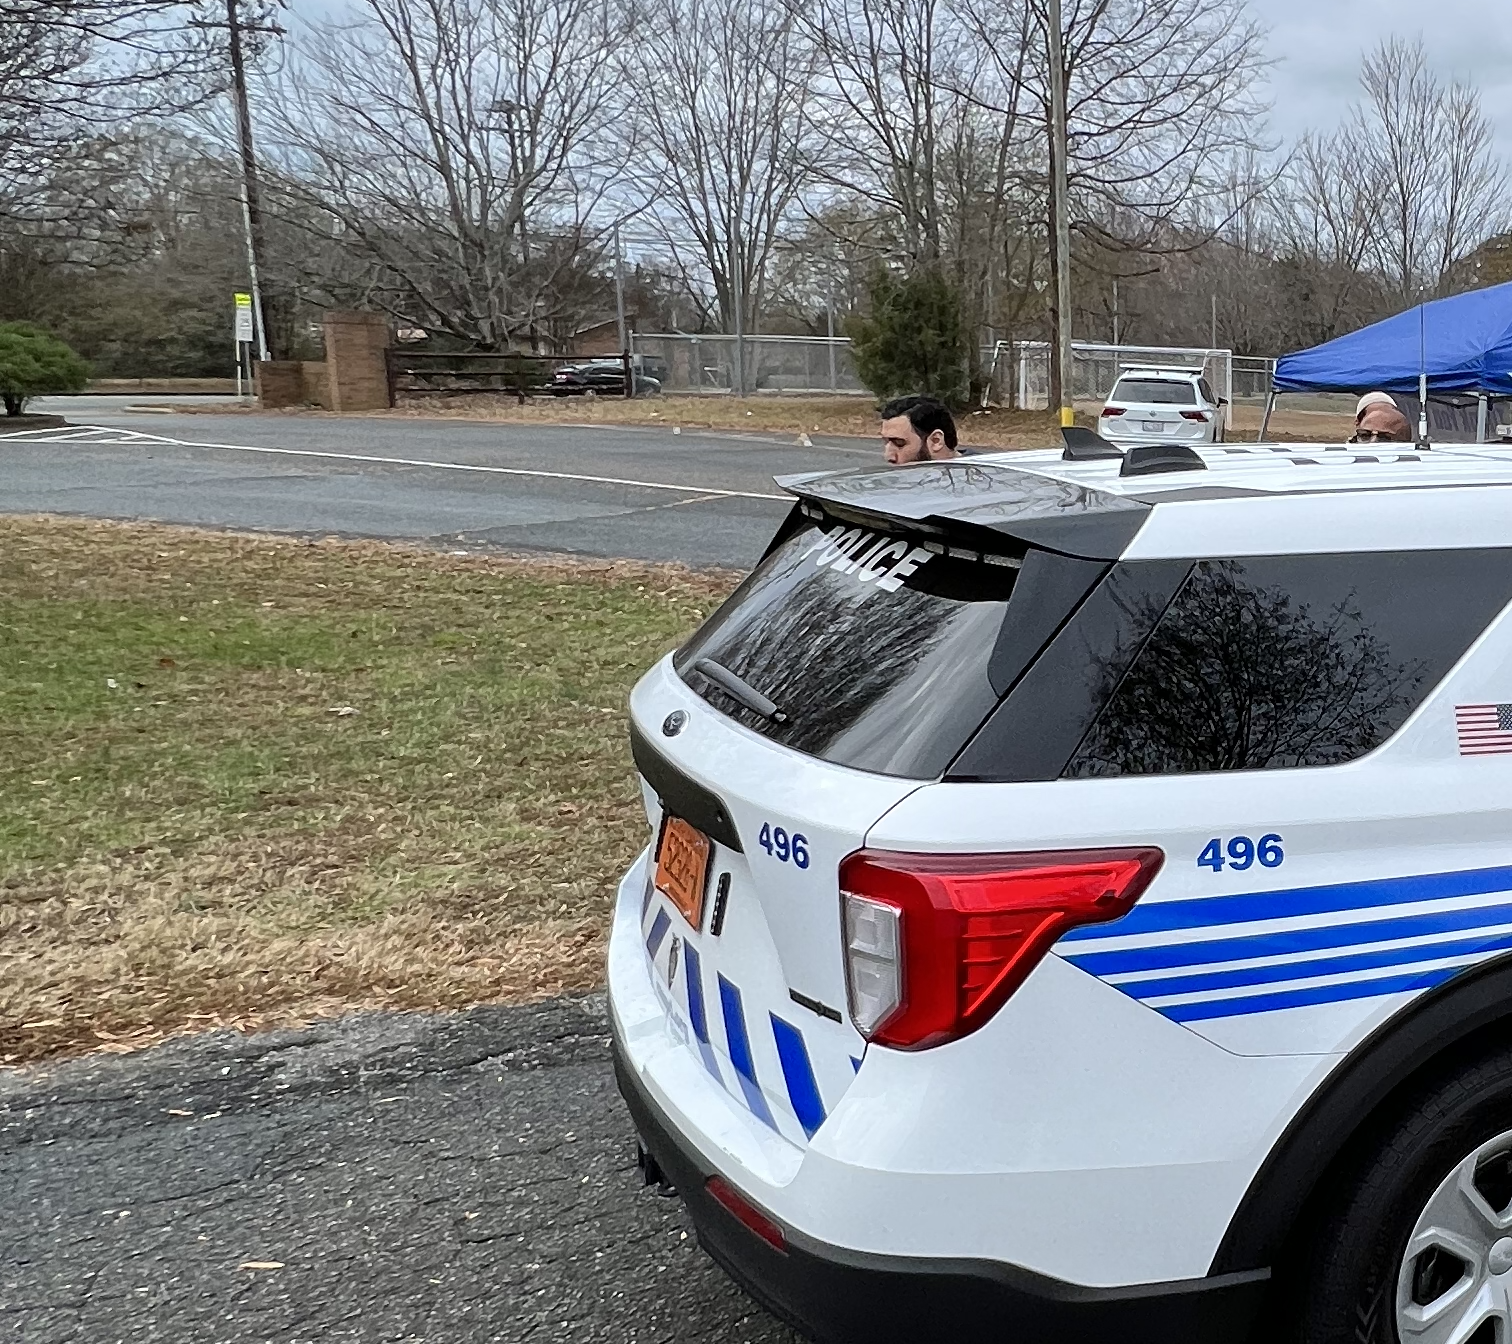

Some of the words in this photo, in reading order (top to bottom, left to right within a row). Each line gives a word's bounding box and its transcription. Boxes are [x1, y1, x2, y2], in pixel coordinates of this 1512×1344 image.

[800, 525, 935, 593] POLICE
[759, 821, 810, 870] 496
[1196, 832, 1285, 873] 496
